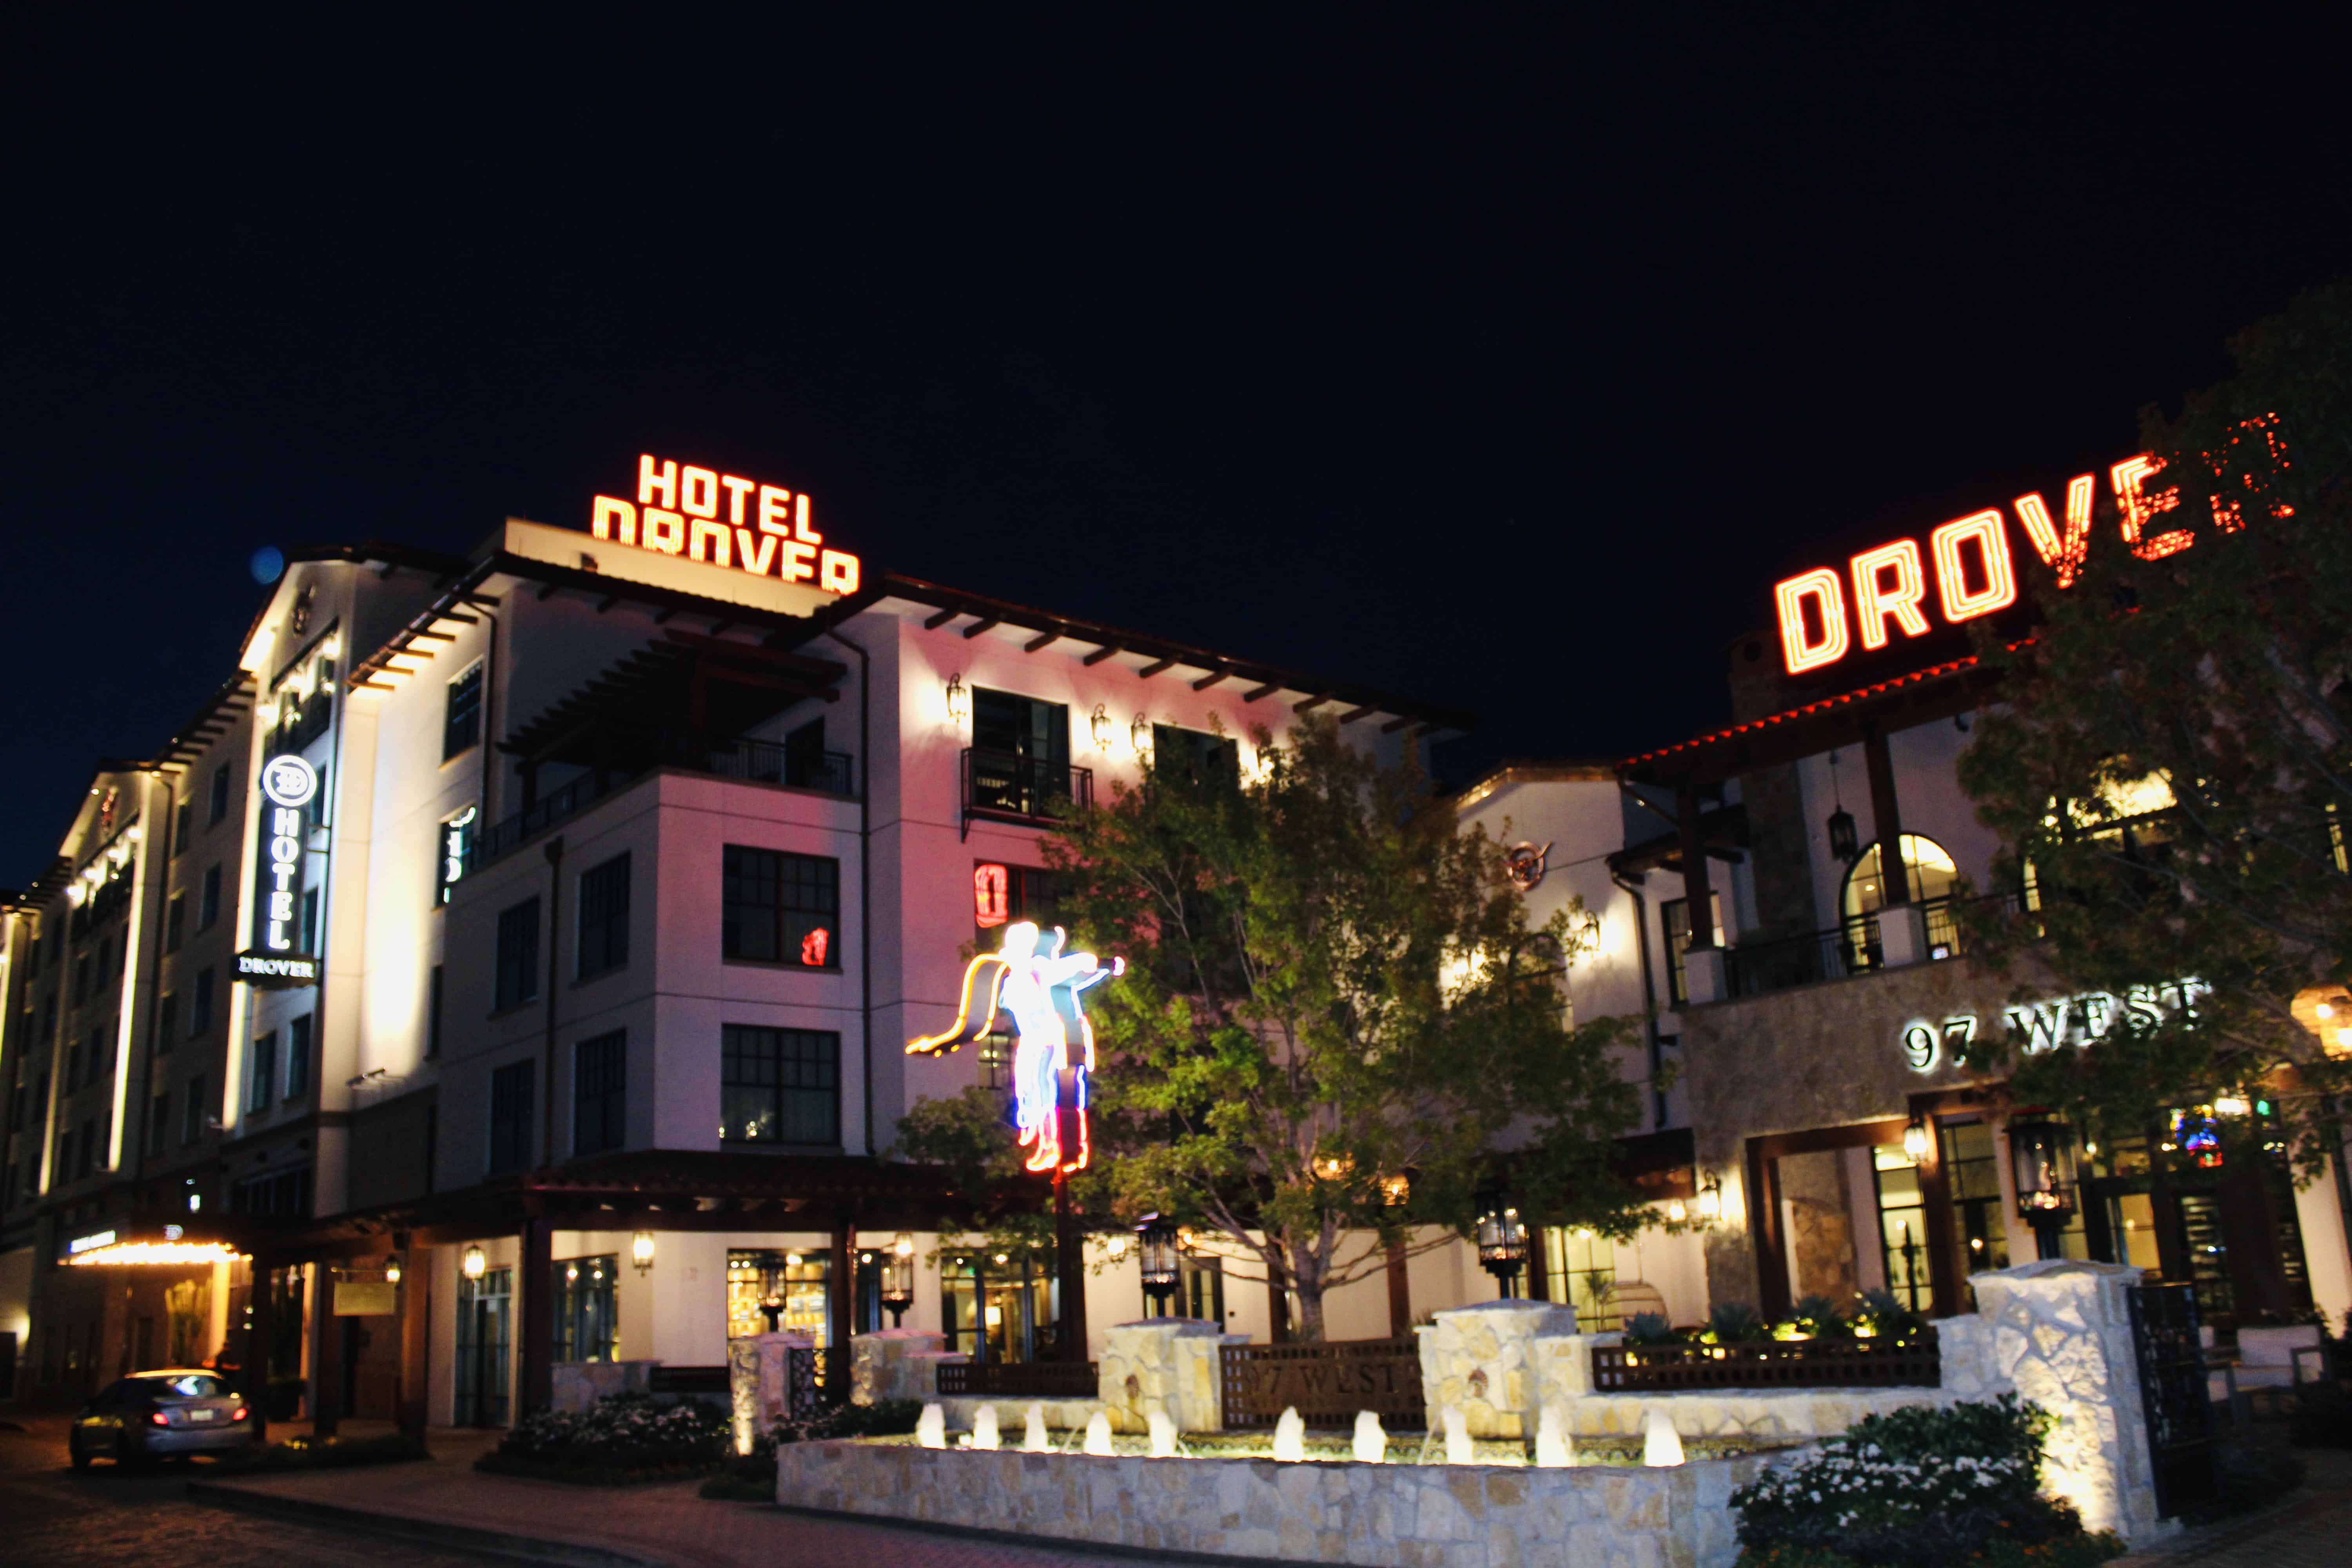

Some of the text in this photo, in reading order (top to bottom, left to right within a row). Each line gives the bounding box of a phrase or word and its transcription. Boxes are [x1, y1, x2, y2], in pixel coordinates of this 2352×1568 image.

[638, 454, 822, 545] HOTEL
[269, 807, 299, 950] HOTEL
[239, 956, 314, 978] DROVER
[1904, 1017, 1975, 1071] 97
[1298, 1363, 1396, 1394] WEST
